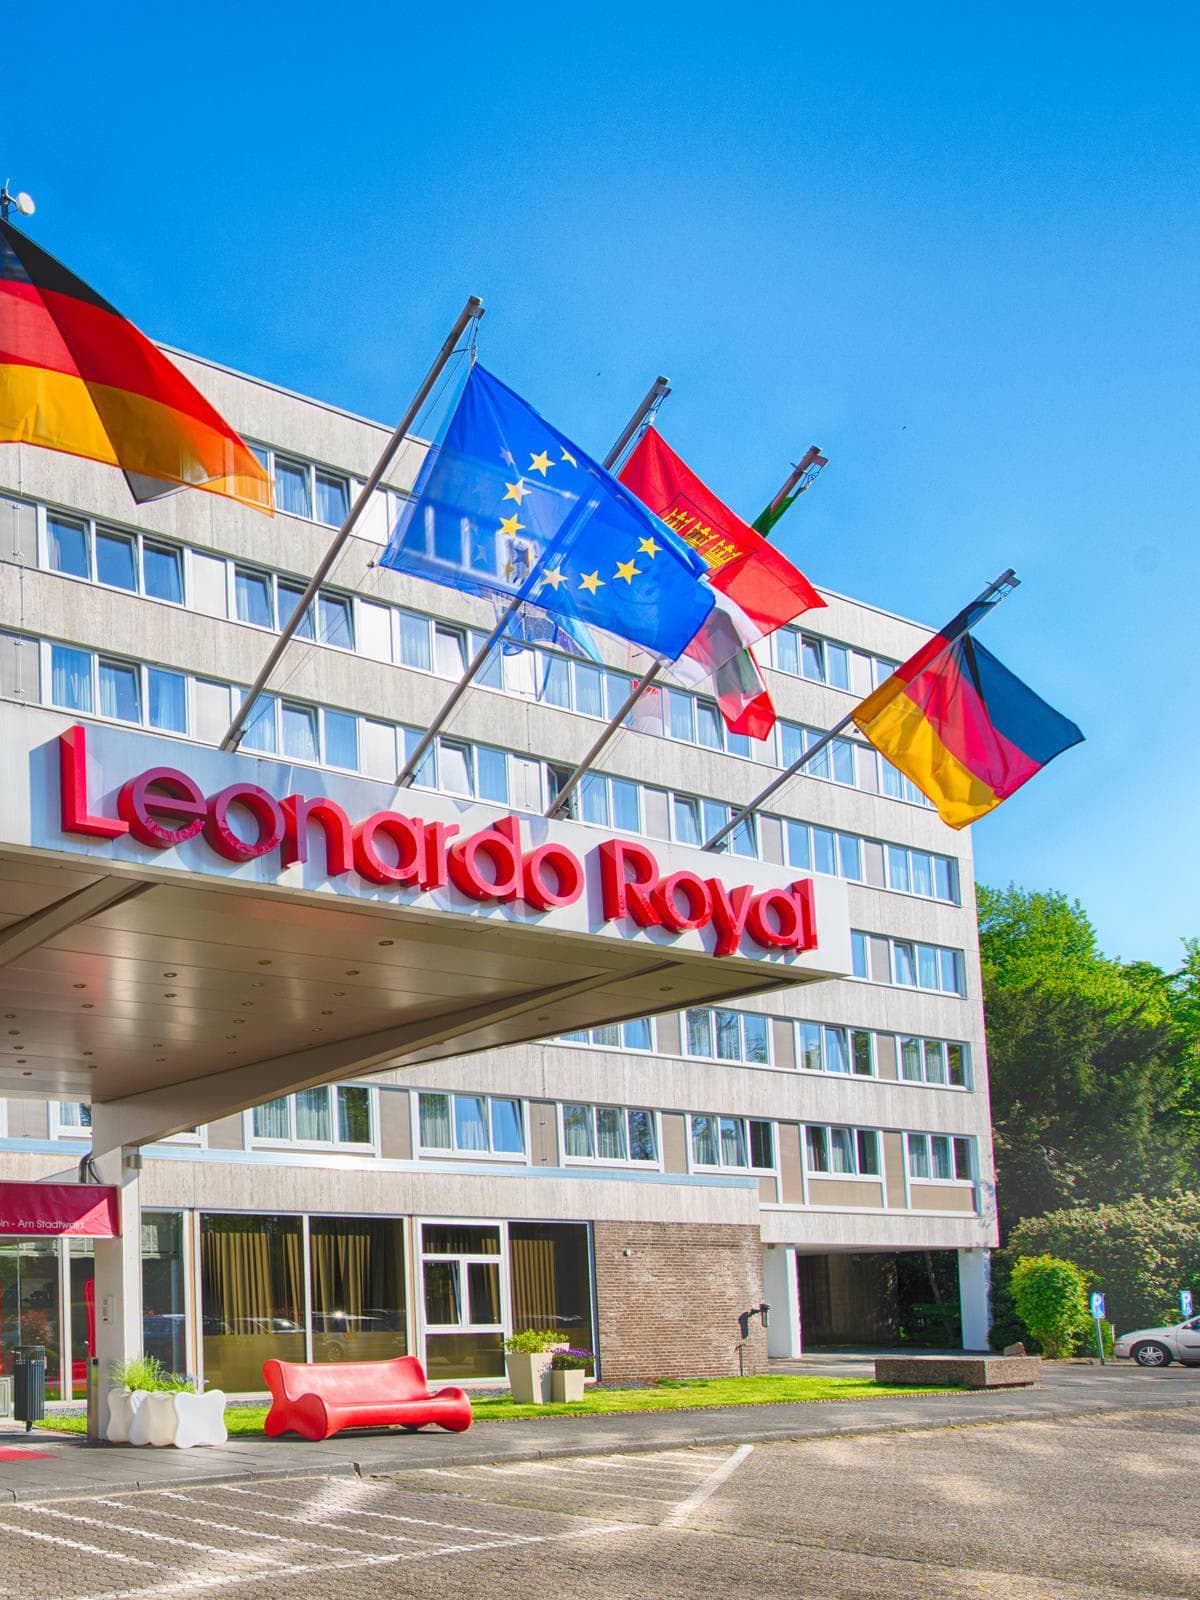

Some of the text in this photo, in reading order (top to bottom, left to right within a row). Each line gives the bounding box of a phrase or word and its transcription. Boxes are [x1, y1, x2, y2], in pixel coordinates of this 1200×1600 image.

[60, 725, 818, 957] Leonardo Royal
[17, 1219, 34, 1229] Am
